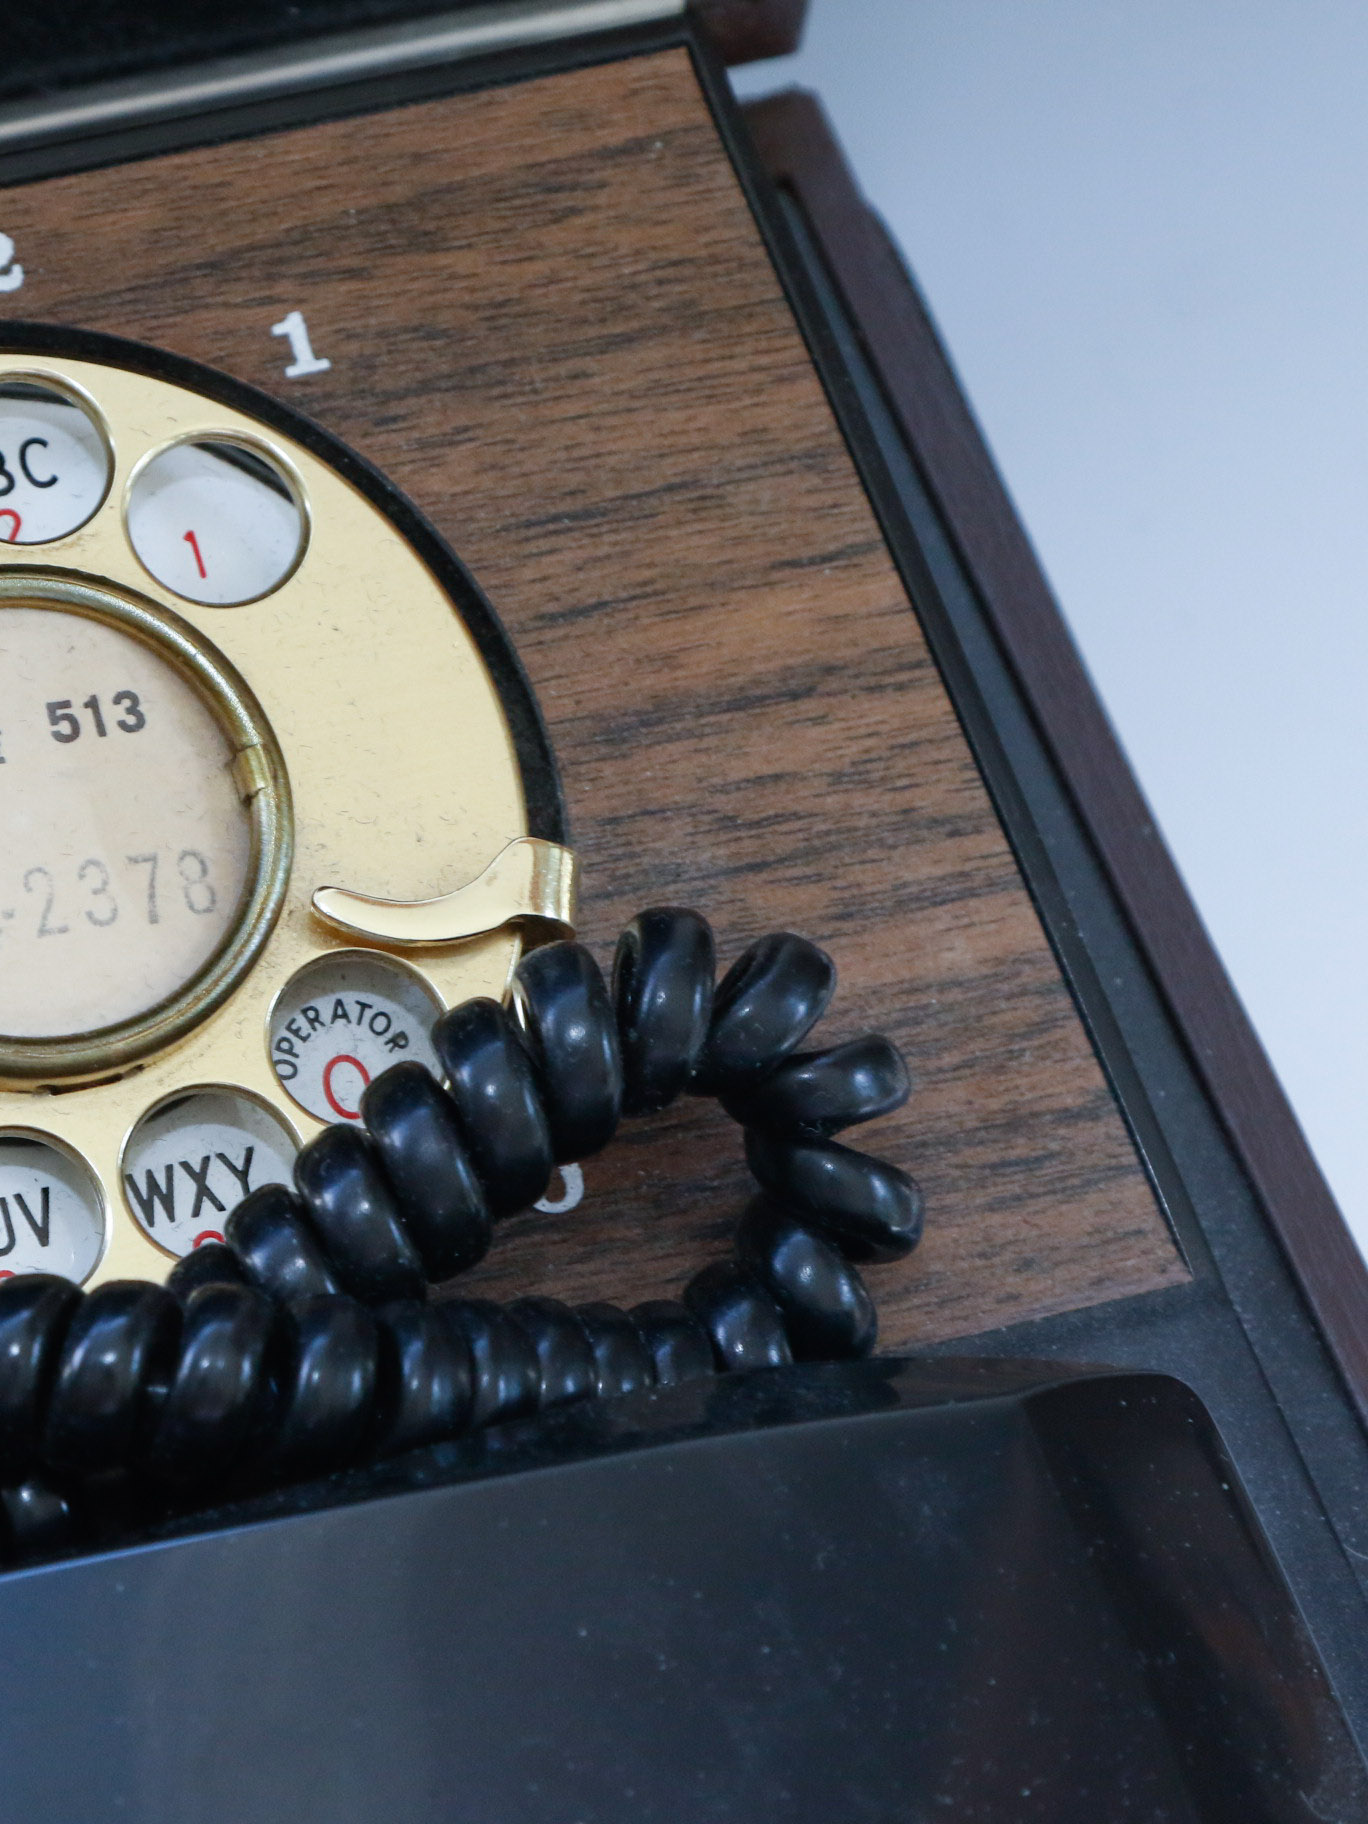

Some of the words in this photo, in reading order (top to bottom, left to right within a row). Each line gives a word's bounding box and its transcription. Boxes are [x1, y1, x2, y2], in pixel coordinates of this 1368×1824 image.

[271, 311, 331, 378] 1
[183, 530, 208, 579] 1
[45, 690, 147, 744] 513
[273, 998, 410, 1081] OPERATOR
[126, 1146, 254, 1228] WXY
